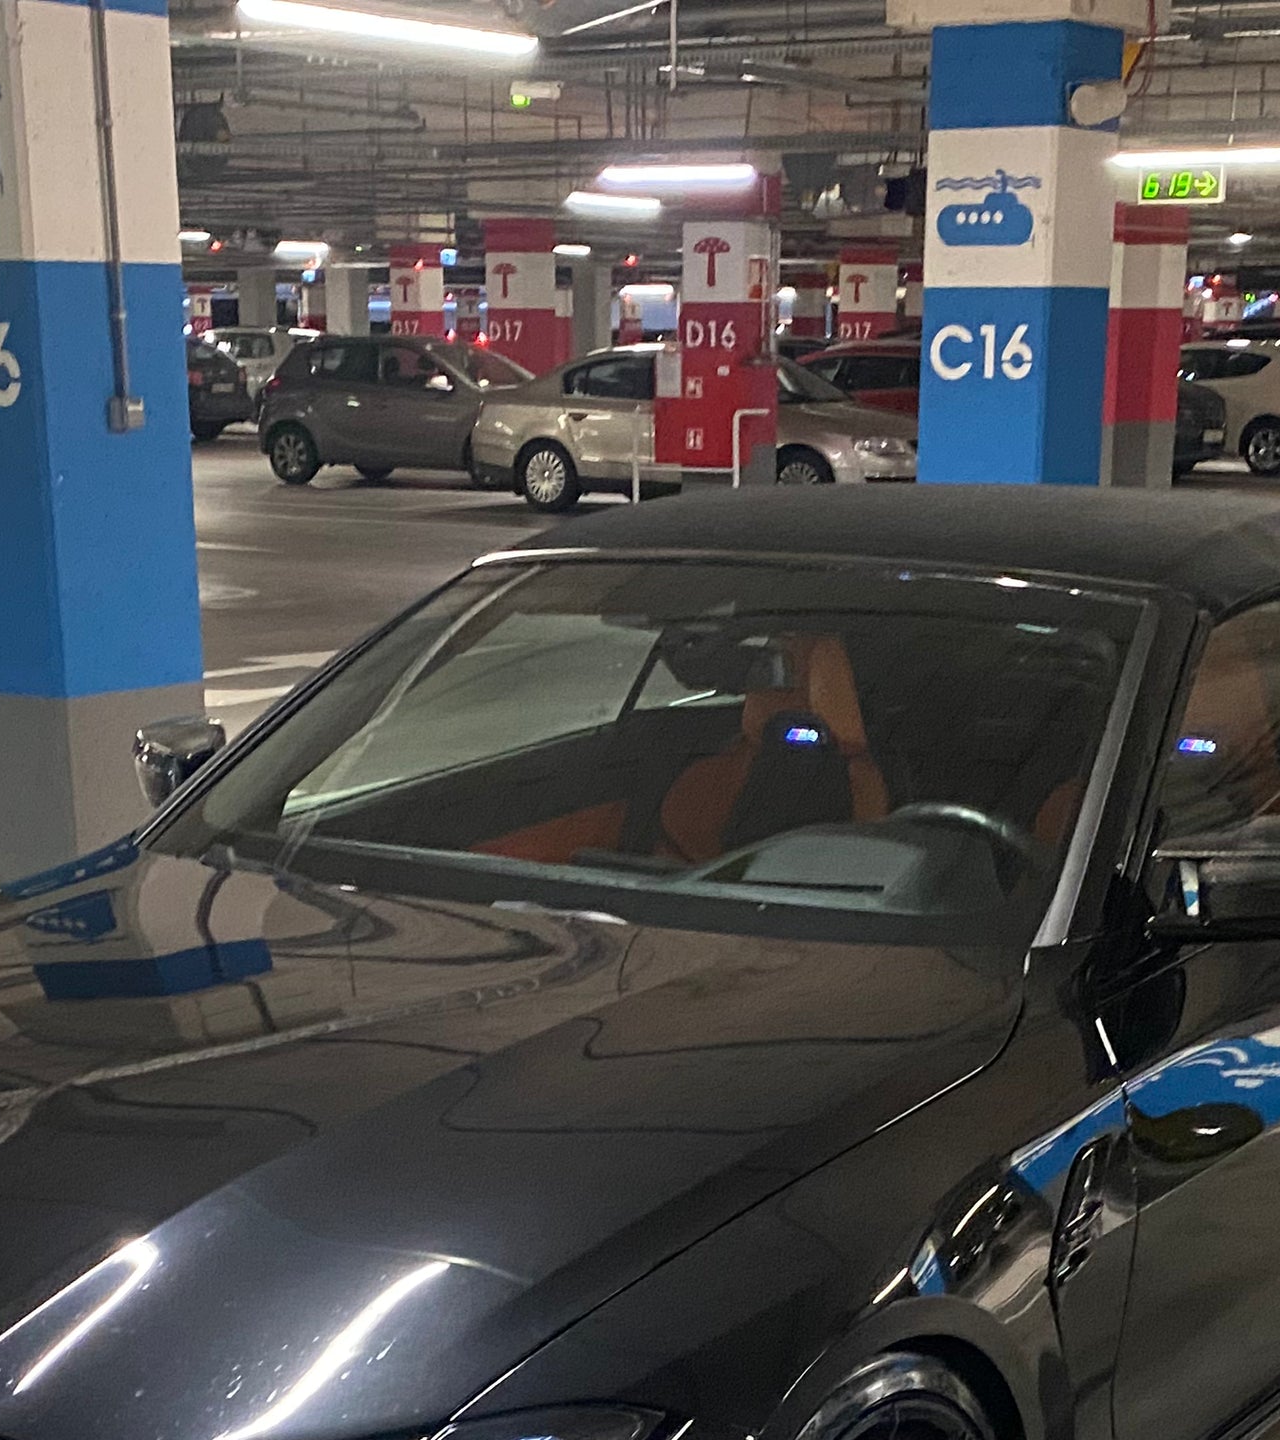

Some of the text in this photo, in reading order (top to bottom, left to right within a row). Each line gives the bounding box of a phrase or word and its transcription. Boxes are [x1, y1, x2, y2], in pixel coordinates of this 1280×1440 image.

[489, 319, 523, 342] D17
[685, 319, 737, 349] D16
[839, 321, 871, 339] D17
[929, 324, 1033, 381] C16
